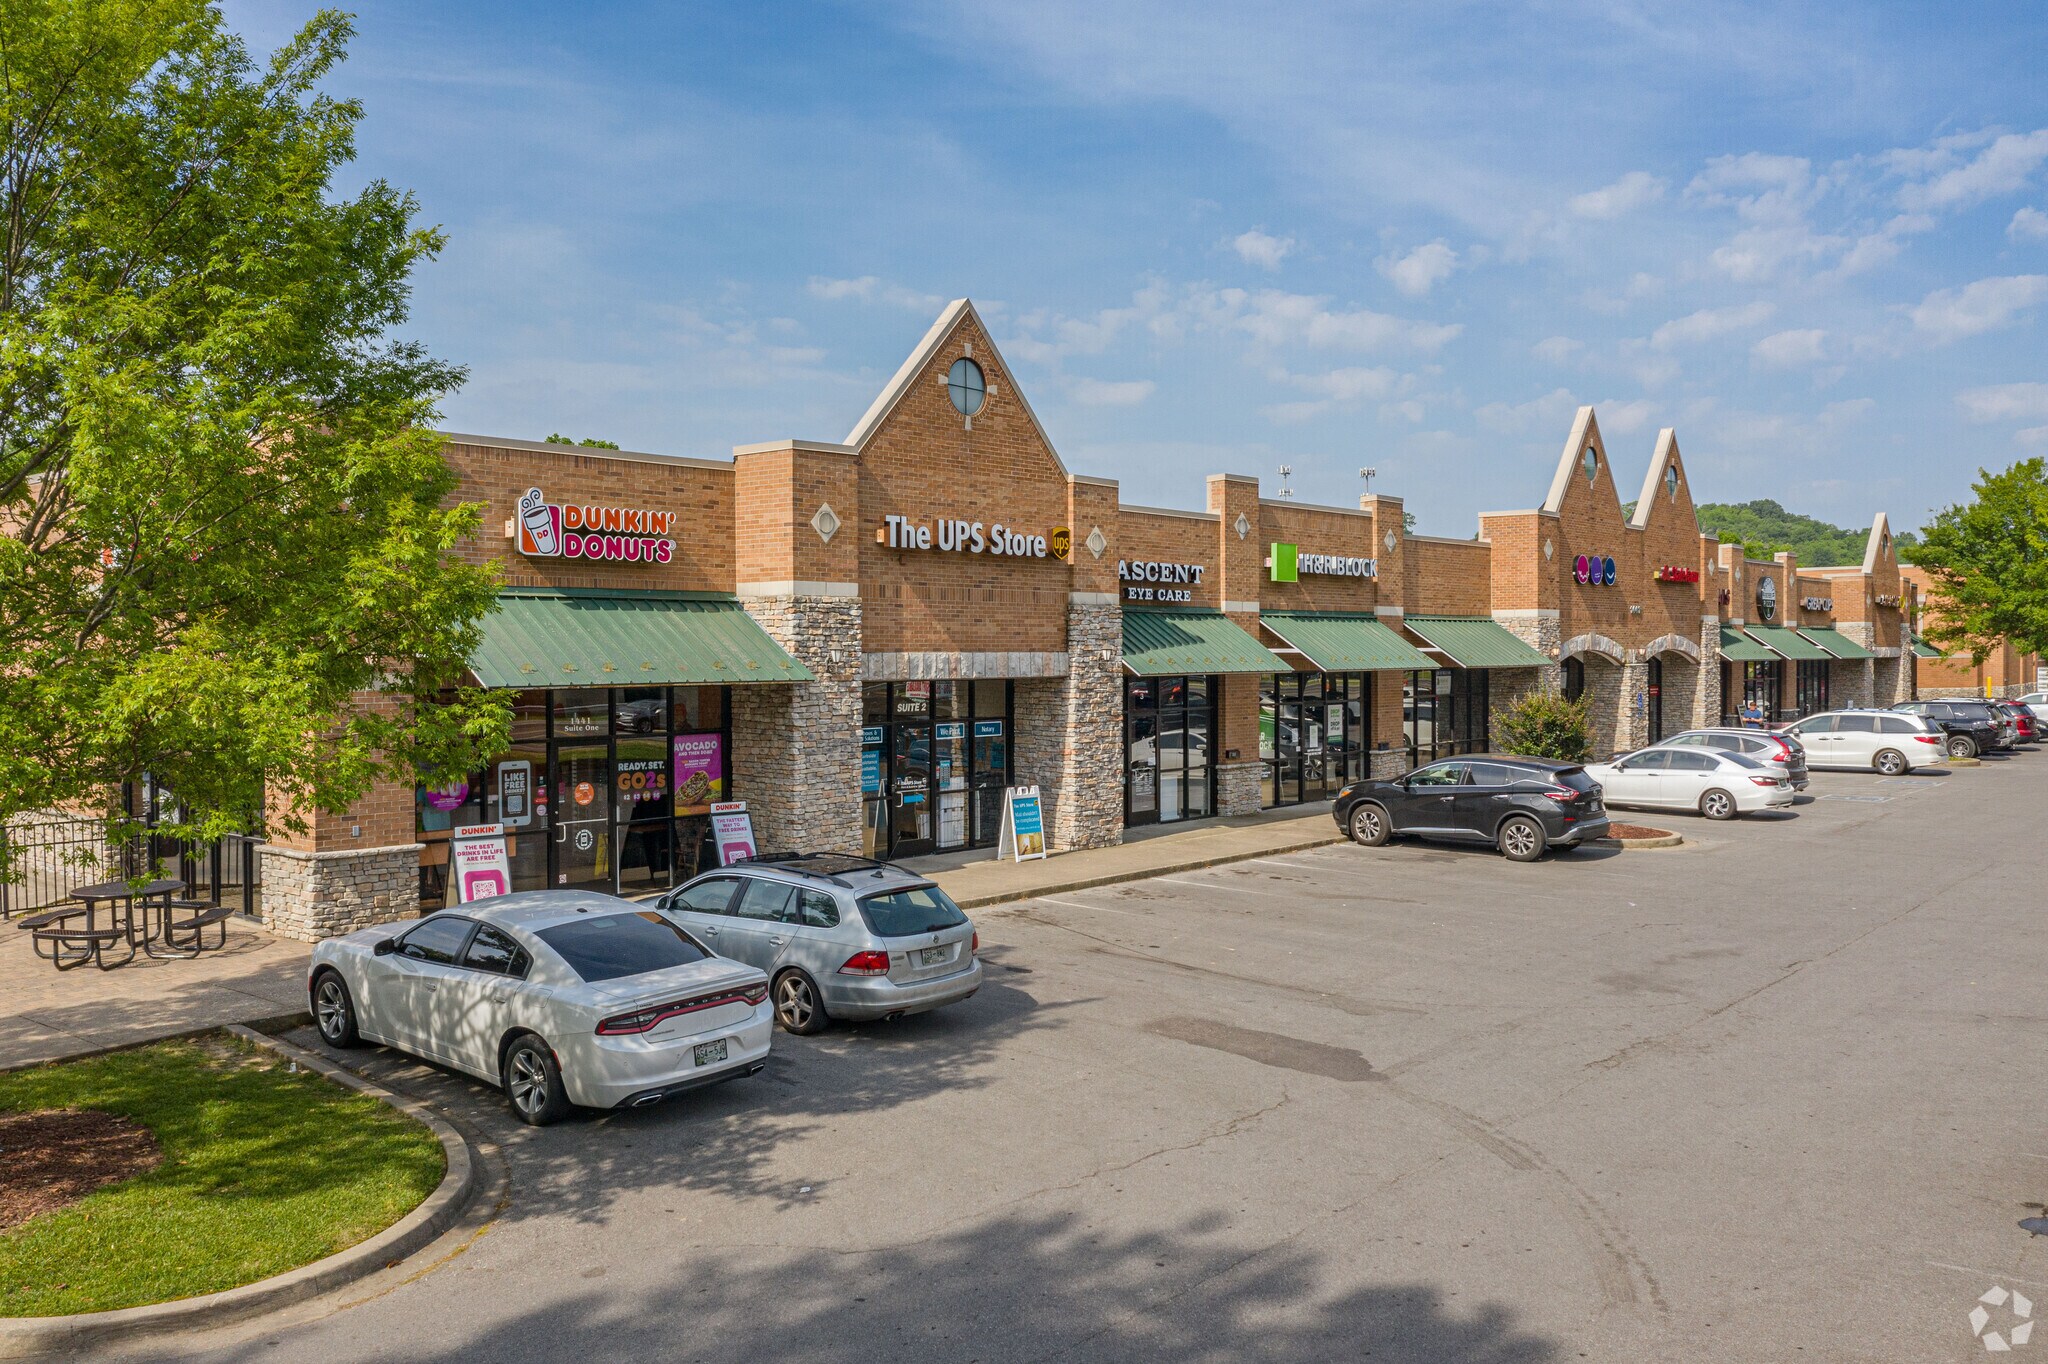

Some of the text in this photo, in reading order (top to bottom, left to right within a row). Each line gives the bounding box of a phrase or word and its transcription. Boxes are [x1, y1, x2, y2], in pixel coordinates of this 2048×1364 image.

[564, 504, 676, 535] DUNKIN'
[886, 515, 1047, 558] The UPS Store
[564, 533, 672, 564] DONUTS
[1054, 537, 1069, 555] ups
[1303, 554, 1378, 577] H&R BLOCK
[1119, 560, 1204, 584] ASCENT
[1128, 587, 1191, 602] EYE CARE
[897, 703, 927, 712] SUITE 2
[981, 726, 995, 734] Notary
[674, 741, 718, 752] AVOCADO
[1259, 741, 1273, 750] OCK
[504, 772, 525, 782] LIKE
[504, 781, 525, 790] FREE
[715, 803, 742, 811] DUNKIN'
[461, 826, 497, 835] DUNKIN'
